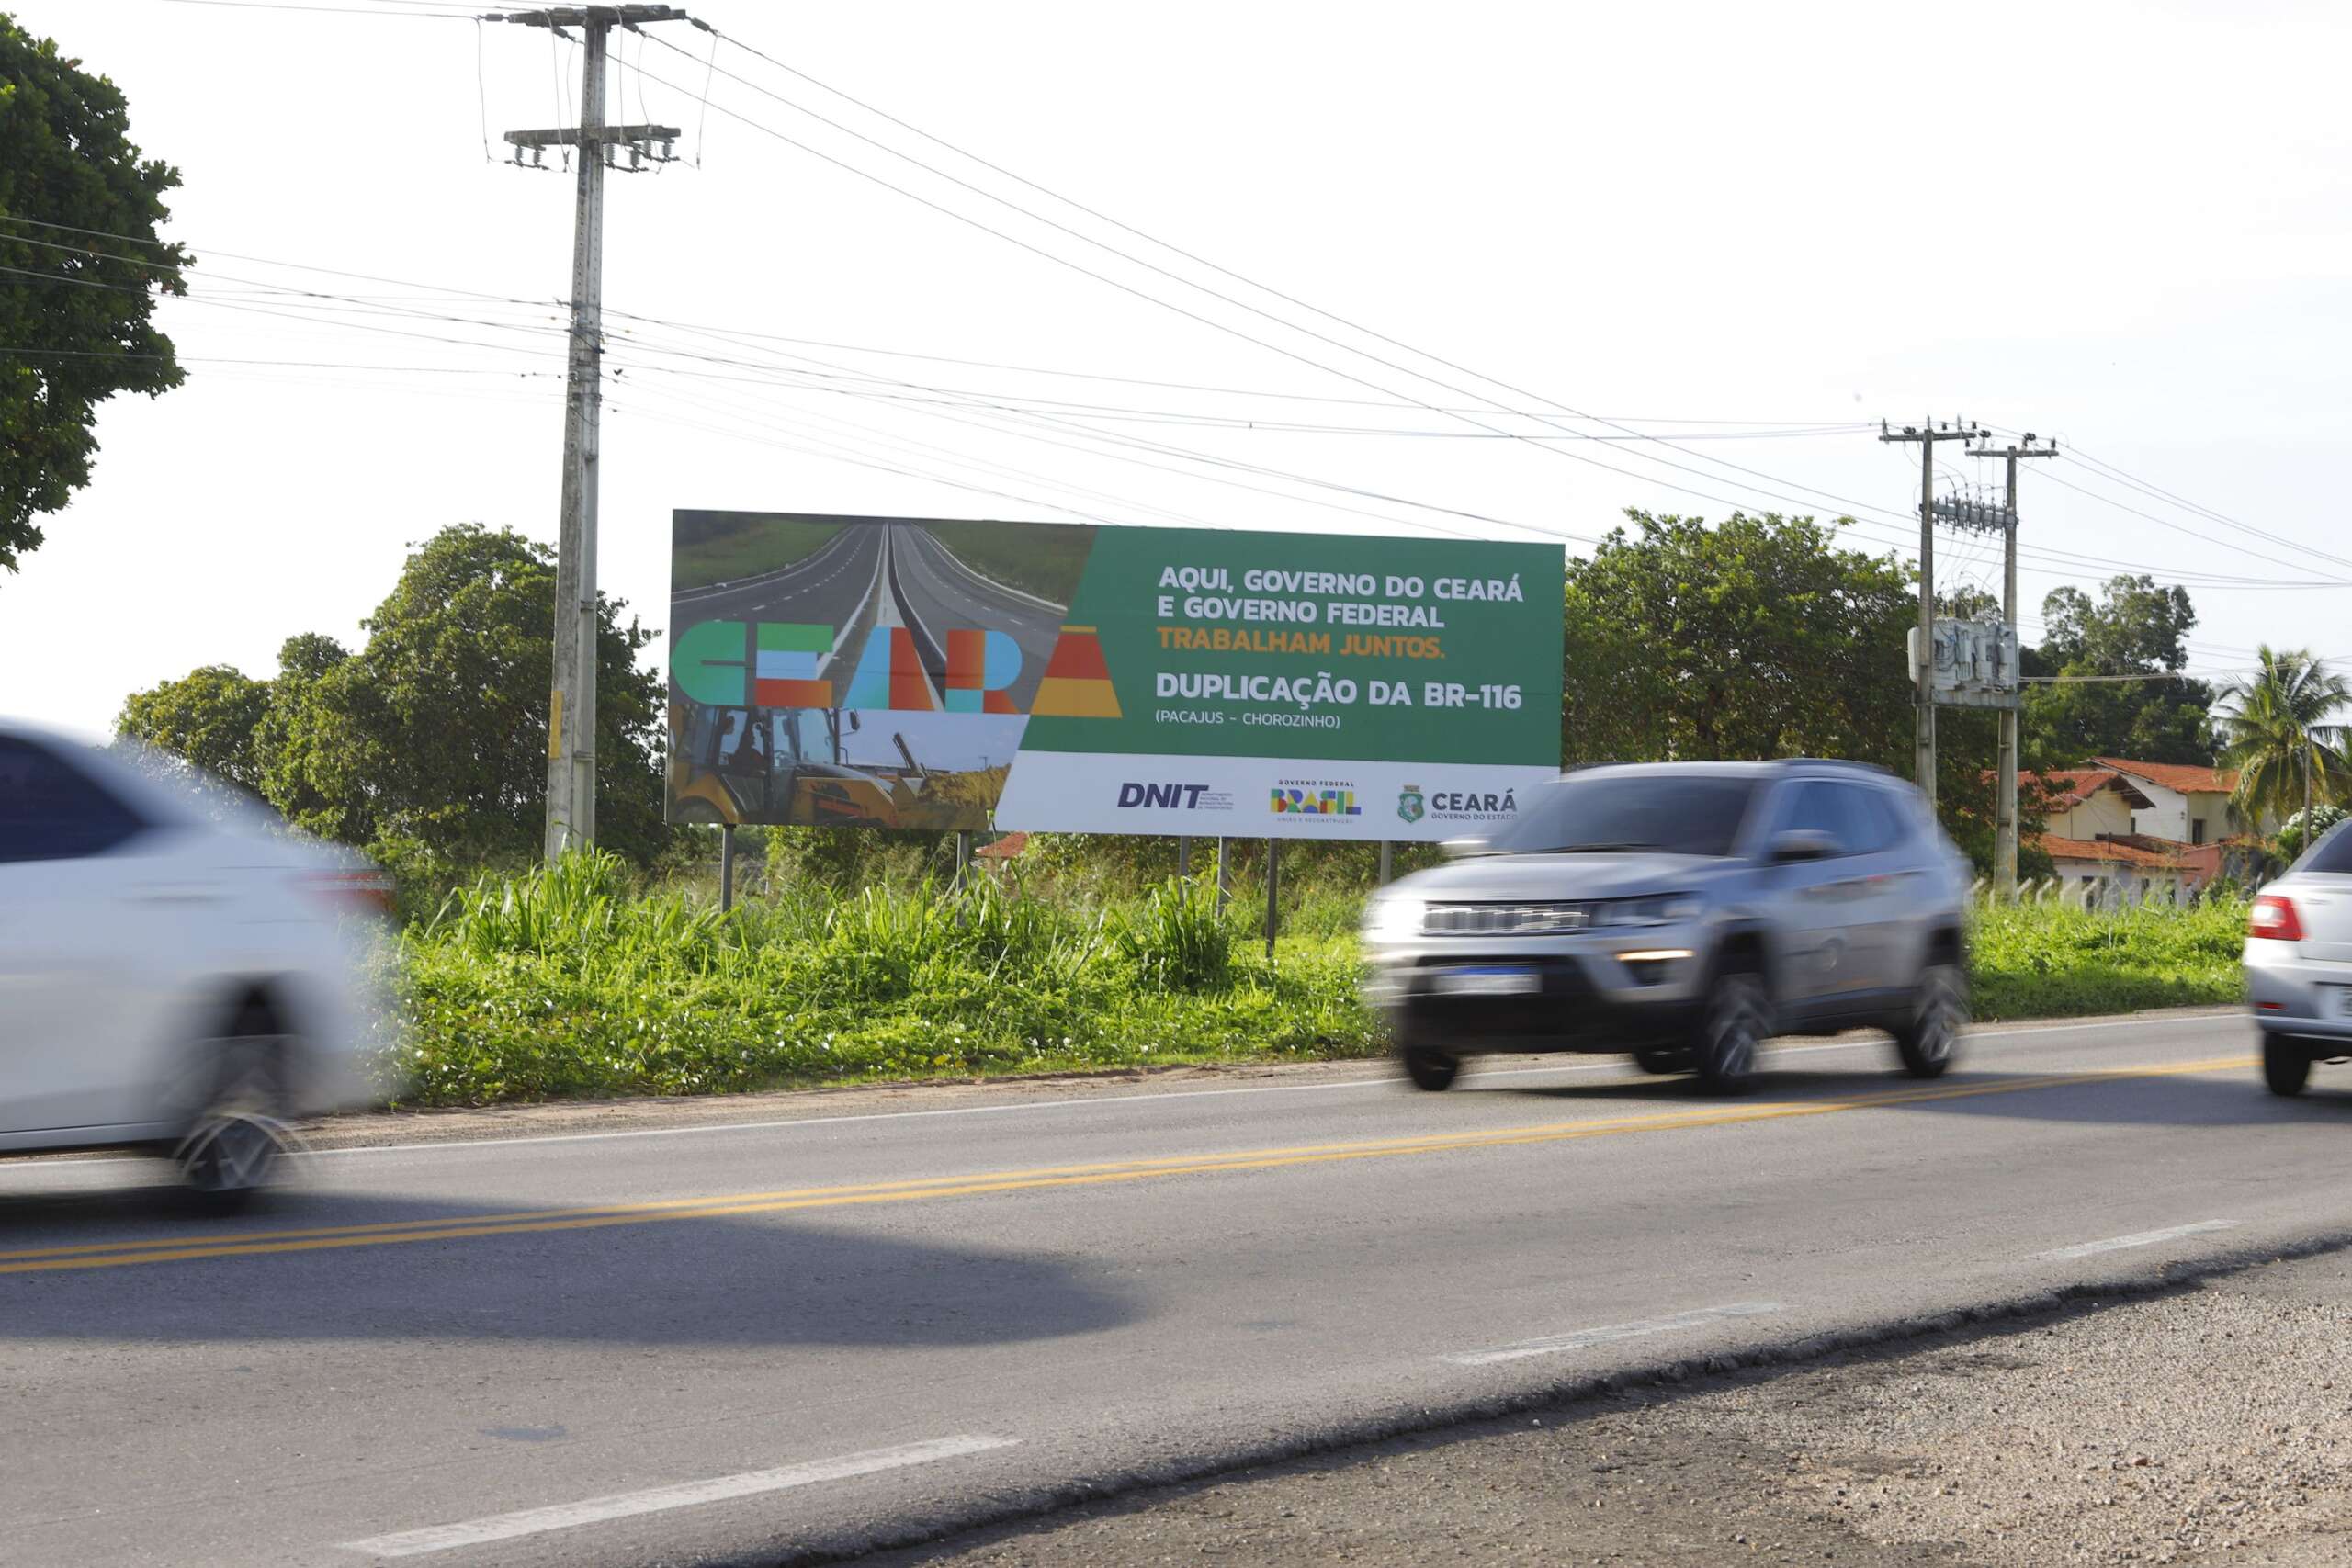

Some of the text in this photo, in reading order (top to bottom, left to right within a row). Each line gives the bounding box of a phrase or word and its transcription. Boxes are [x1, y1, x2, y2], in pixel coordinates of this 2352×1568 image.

[1159, 566, 1524, 603] AQUI, GOVERNO DO CEARÁ
[1158, 595, 1445, 628] E GOVERNO FEDERAL
[1157, 626, 1446, 660] TRABALHAM JUNTOS.
[1156, 671, 1522, 711] DUPLICAÇÃO DA BR-116
[1155, 709, 1224, 724] (PACAJUS
[1242, 713, 1341, 729] CHOROZINHO)
[1117, 783, 1210, 809] DNIT
[1270, 788, 1362, 816] BRASIL
[1431, 787, 1518, 812] CEARÁ
[1431, 813, 1471, 821] GOVERNO
